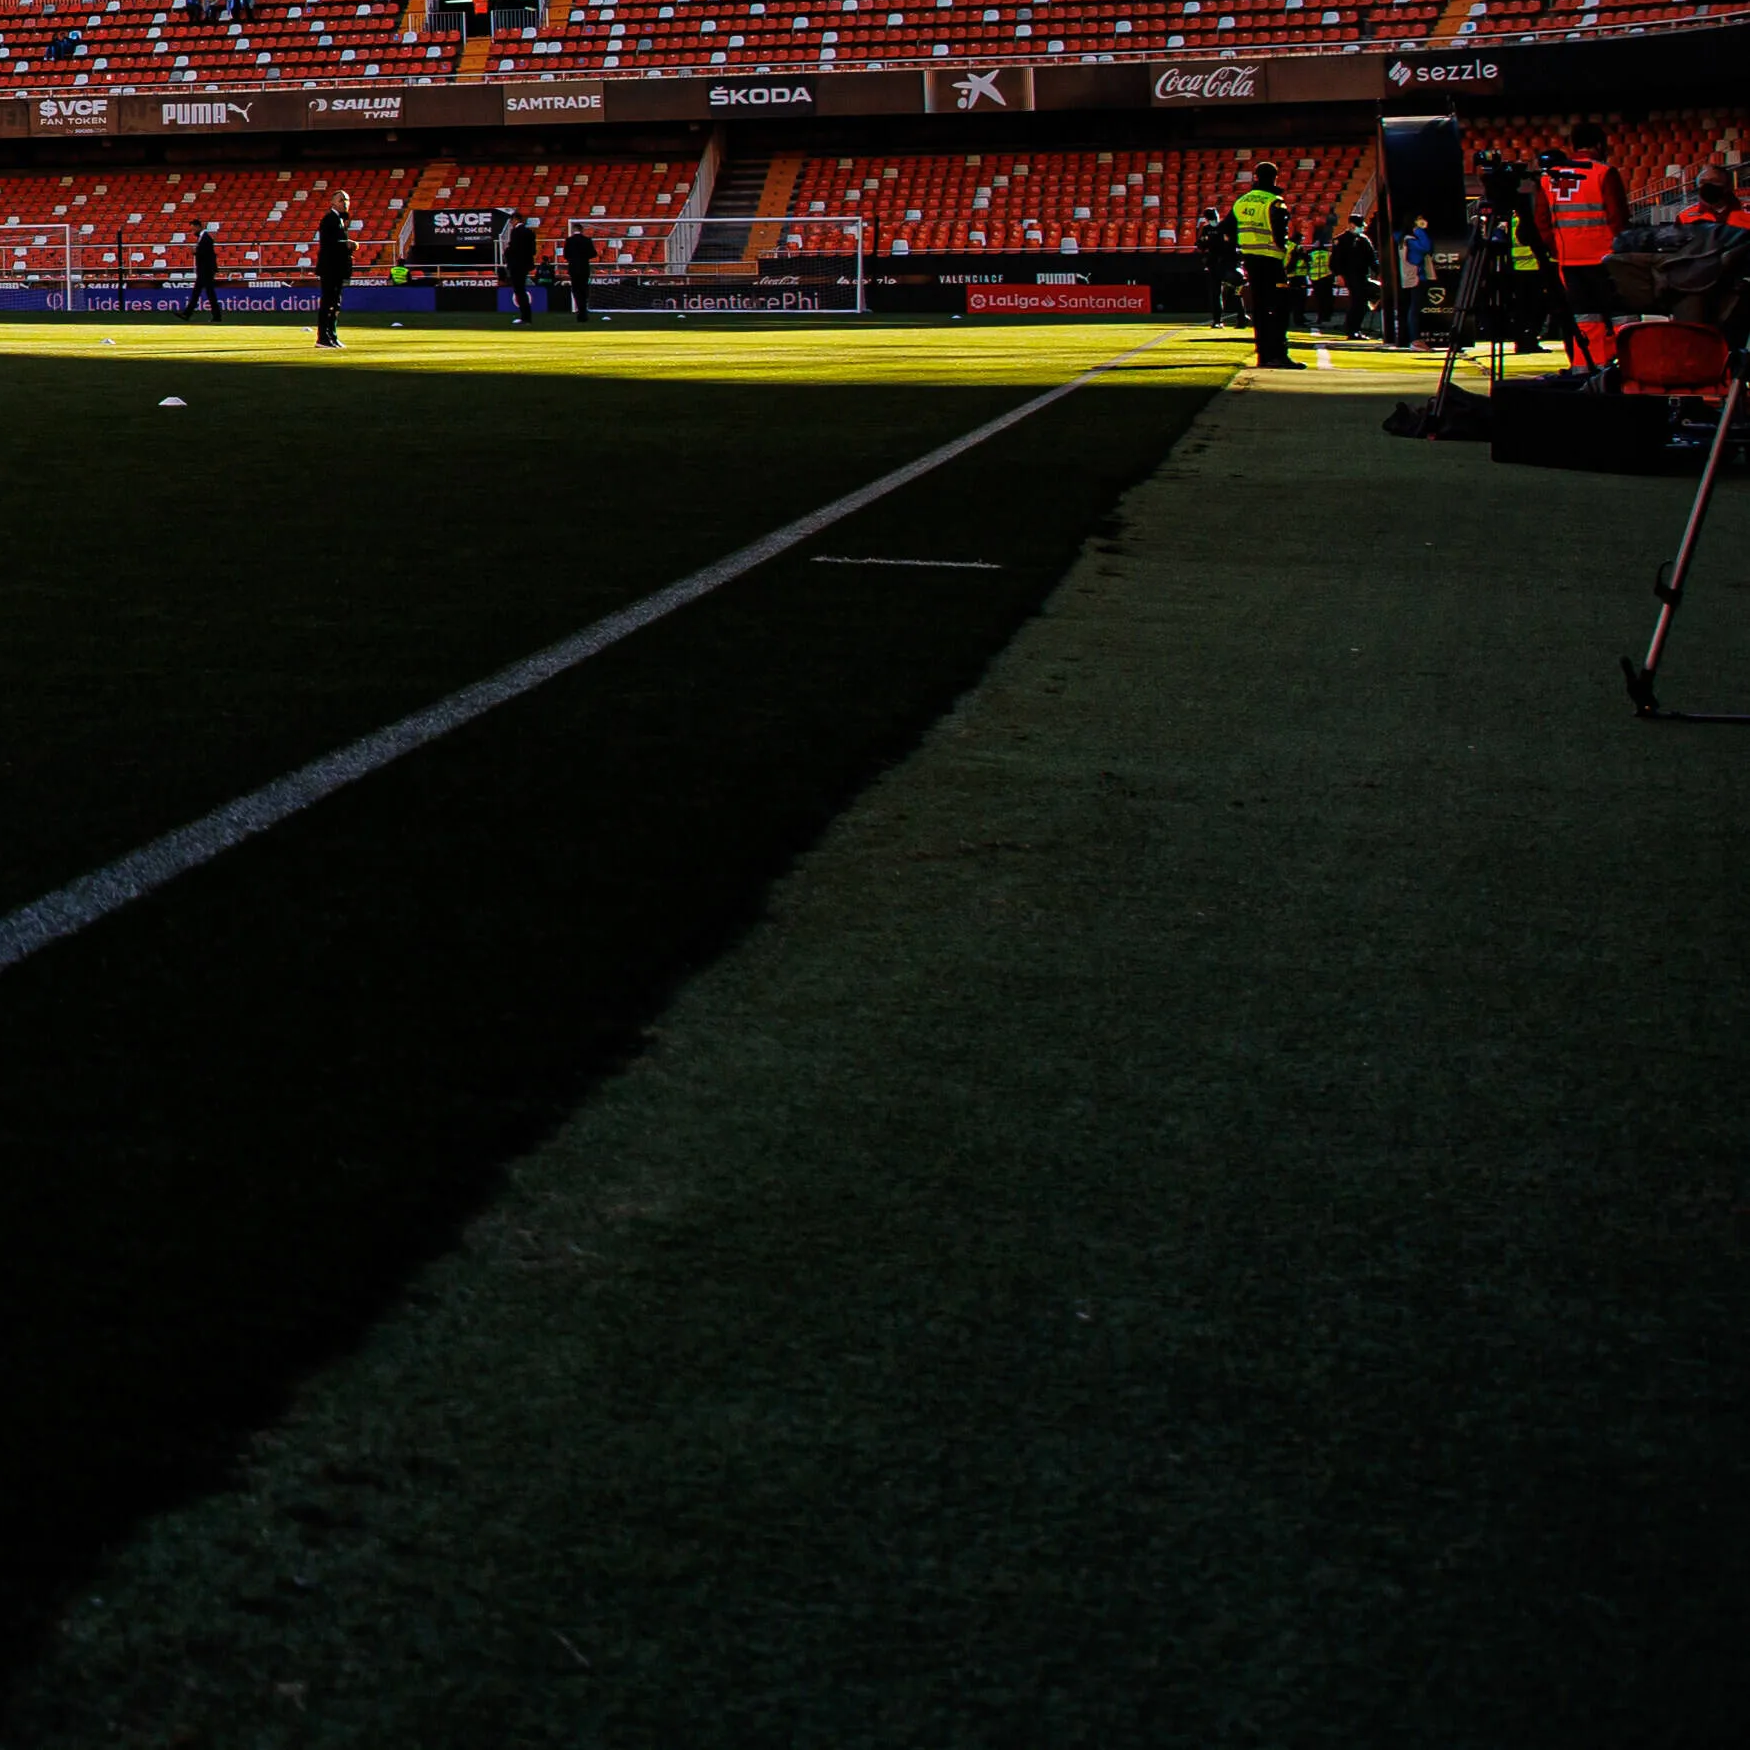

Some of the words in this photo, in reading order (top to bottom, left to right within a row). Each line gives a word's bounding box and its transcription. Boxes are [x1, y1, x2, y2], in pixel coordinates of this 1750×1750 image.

[1417, 59, 1499, 82] sezzle
[1155, 65, 1260, 99] Coca-Cola
[506, 94, 601, 111] SAMTRADE
[709, 85, 812, 106] ŠKODA
[39, 99, 108, 118] $VCF
[331, 97, 401, 111] SAILUN
[162, 102, 230, 125] PUMA
[363, 110, 399, 119] TYRE
[40, 118, 63, 126] FAN
[68, 116, 107, 125] TOKEN
[434, 212, 493, 228] $VCF
[434, 227, 454, 235] FAN
[458, 226, 492, 234] TOKEN
[442, 279, 499, 288] SAMTRADE
[939, 274, 1005, 285] VALENCIACF
[1036, 273, 1077, 285] PUMA
[156, 299, 180, 311] en
[988, 294, 1039, 309] LaLiga
[1058, 294, 1145, 308] Santander
